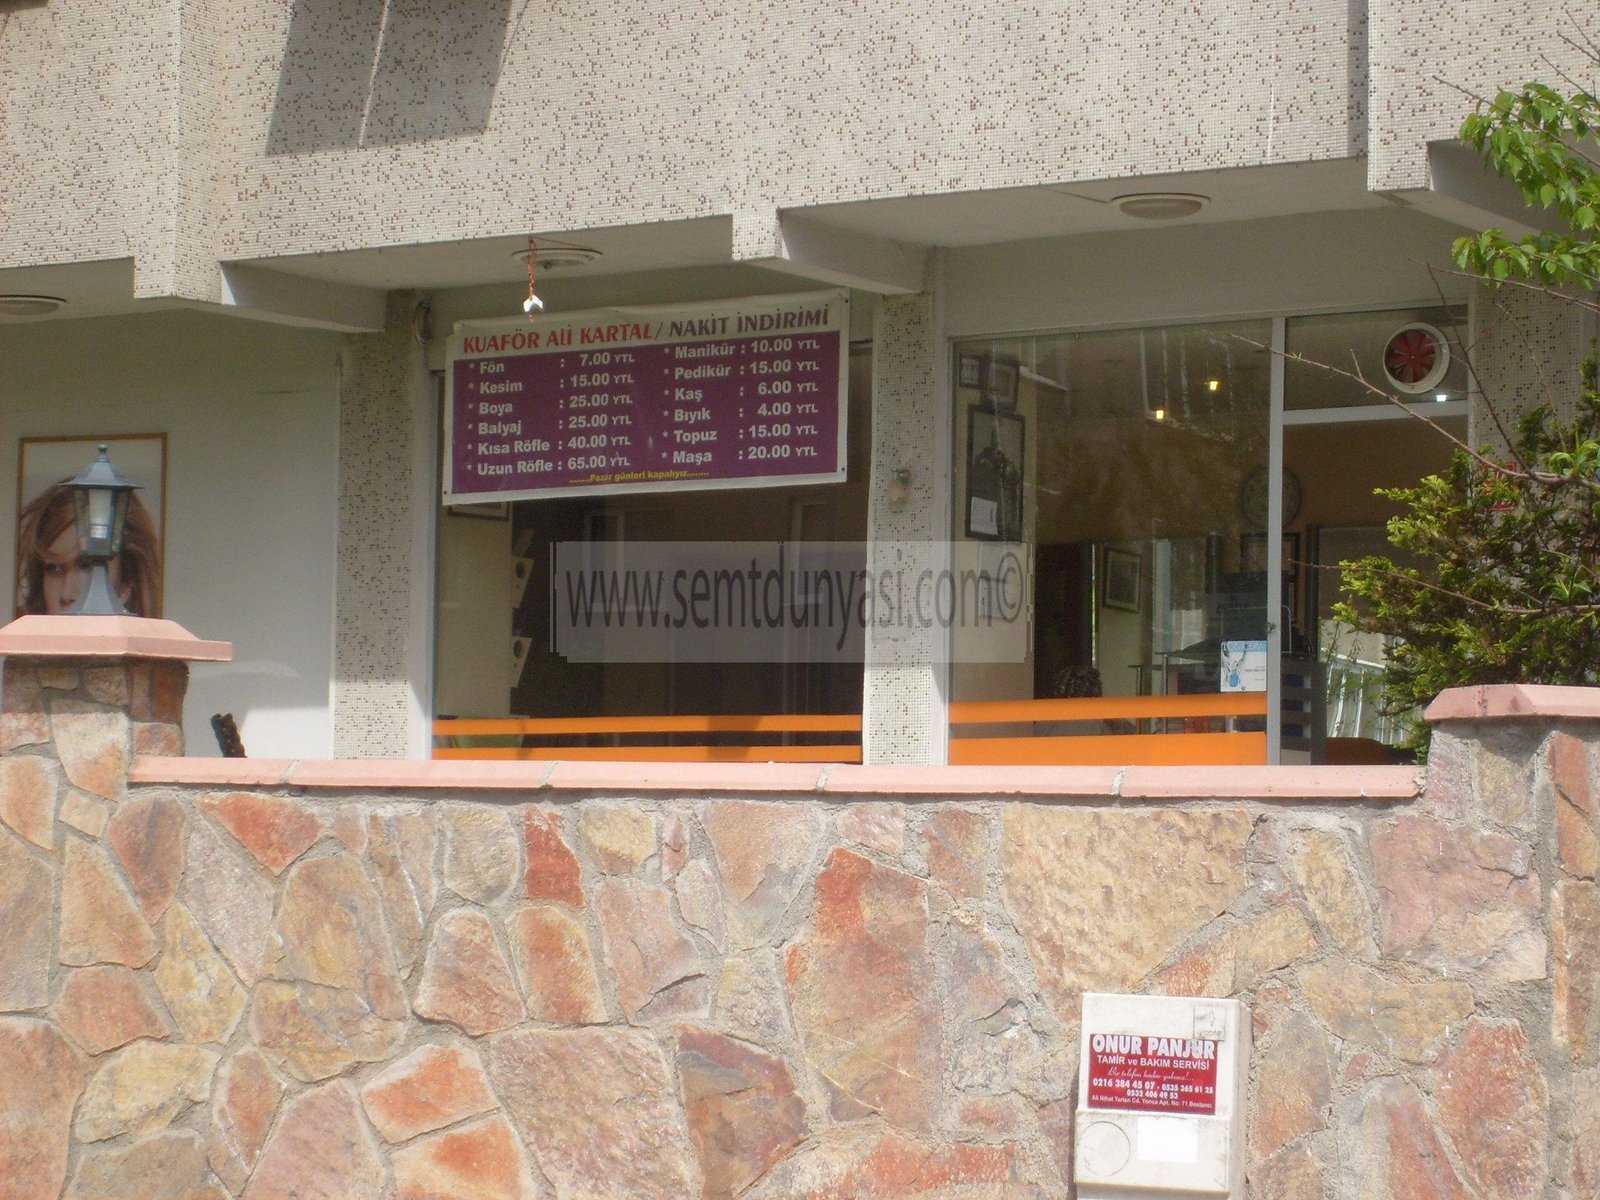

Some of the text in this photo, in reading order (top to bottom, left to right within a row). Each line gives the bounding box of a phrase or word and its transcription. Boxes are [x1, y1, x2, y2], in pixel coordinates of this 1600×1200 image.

[464, 329, 539, 353] KUAFÖR
[669, 313, 729, 337] NAKİT
[737, 304, 829, 333] İNDİRİMİ
[675, 339, 819, 358] Manikür 10.00 YTL
[480, 353, 635, 373] Fön 7.00 YTL
[675, 360, 819, 379] Pedikür 15.00 YTL
[480, 373, 634, 394] Kesim 15.00 YTL
[675, 382, 818, 401] Kaş 6.00 YTL
[479, 394, 633, 416] Boya 25.00 YTL
[674, 403, 818, 424] Bıyık 4.00 YTL
[479, 415, 631, 436] Balyaj 25.00 YTL
[674, 424, 817, 444] Topuz 15.00 YTL
[478, 436, 630, 455] Kısa Röfle 40.00 YTL
[673, 445, 817, 465] Maşa 20.00 YTL
[477, 456, 630, 475] Uzun Röfle 65.00 YTL
[1093, 1035, 1142, 1055] ONUR
[1097, 1055, 1124, 1065] TAMİR
[1140, 1058, 1170, 1067] BAKIM
[1173, 1059, 1210, 1070] SERVİSİ
[1093, 1077, 1113, 1087] 0216
